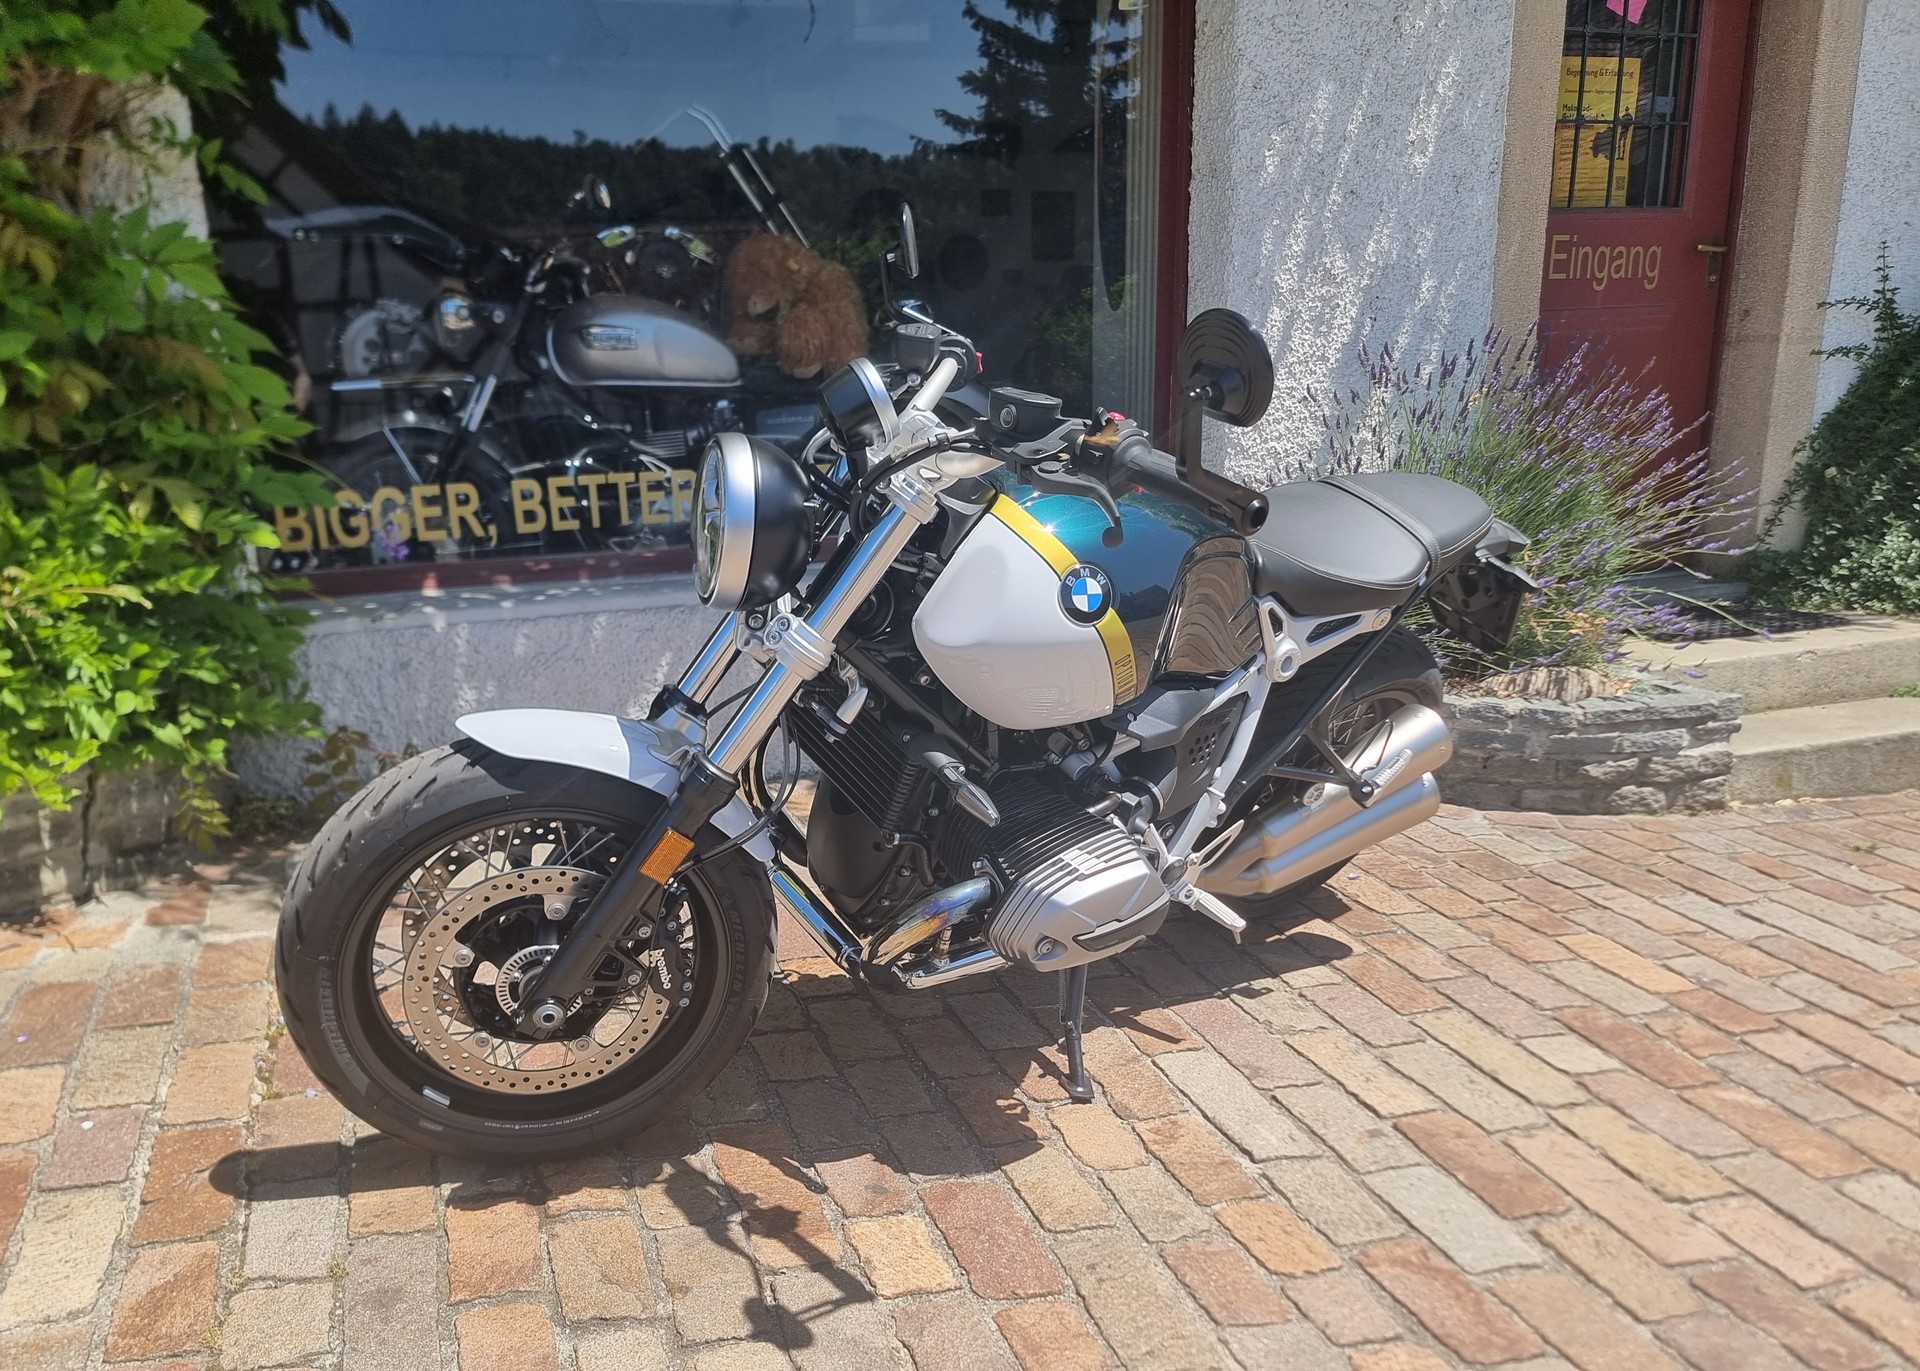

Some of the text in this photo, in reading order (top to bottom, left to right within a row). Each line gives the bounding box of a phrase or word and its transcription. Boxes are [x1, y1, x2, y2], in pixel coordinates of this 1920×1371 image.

[1548, 235, 1662, 291] Eingang
[273, 482, 498, 553] BIGGER,
[1065, 567, 1106, 587] BMW
[1114, 653, 1135, 692] OPTION
[655, 948, 672, 990] brembo
[729, 910, 747, 995] MICHELIN
